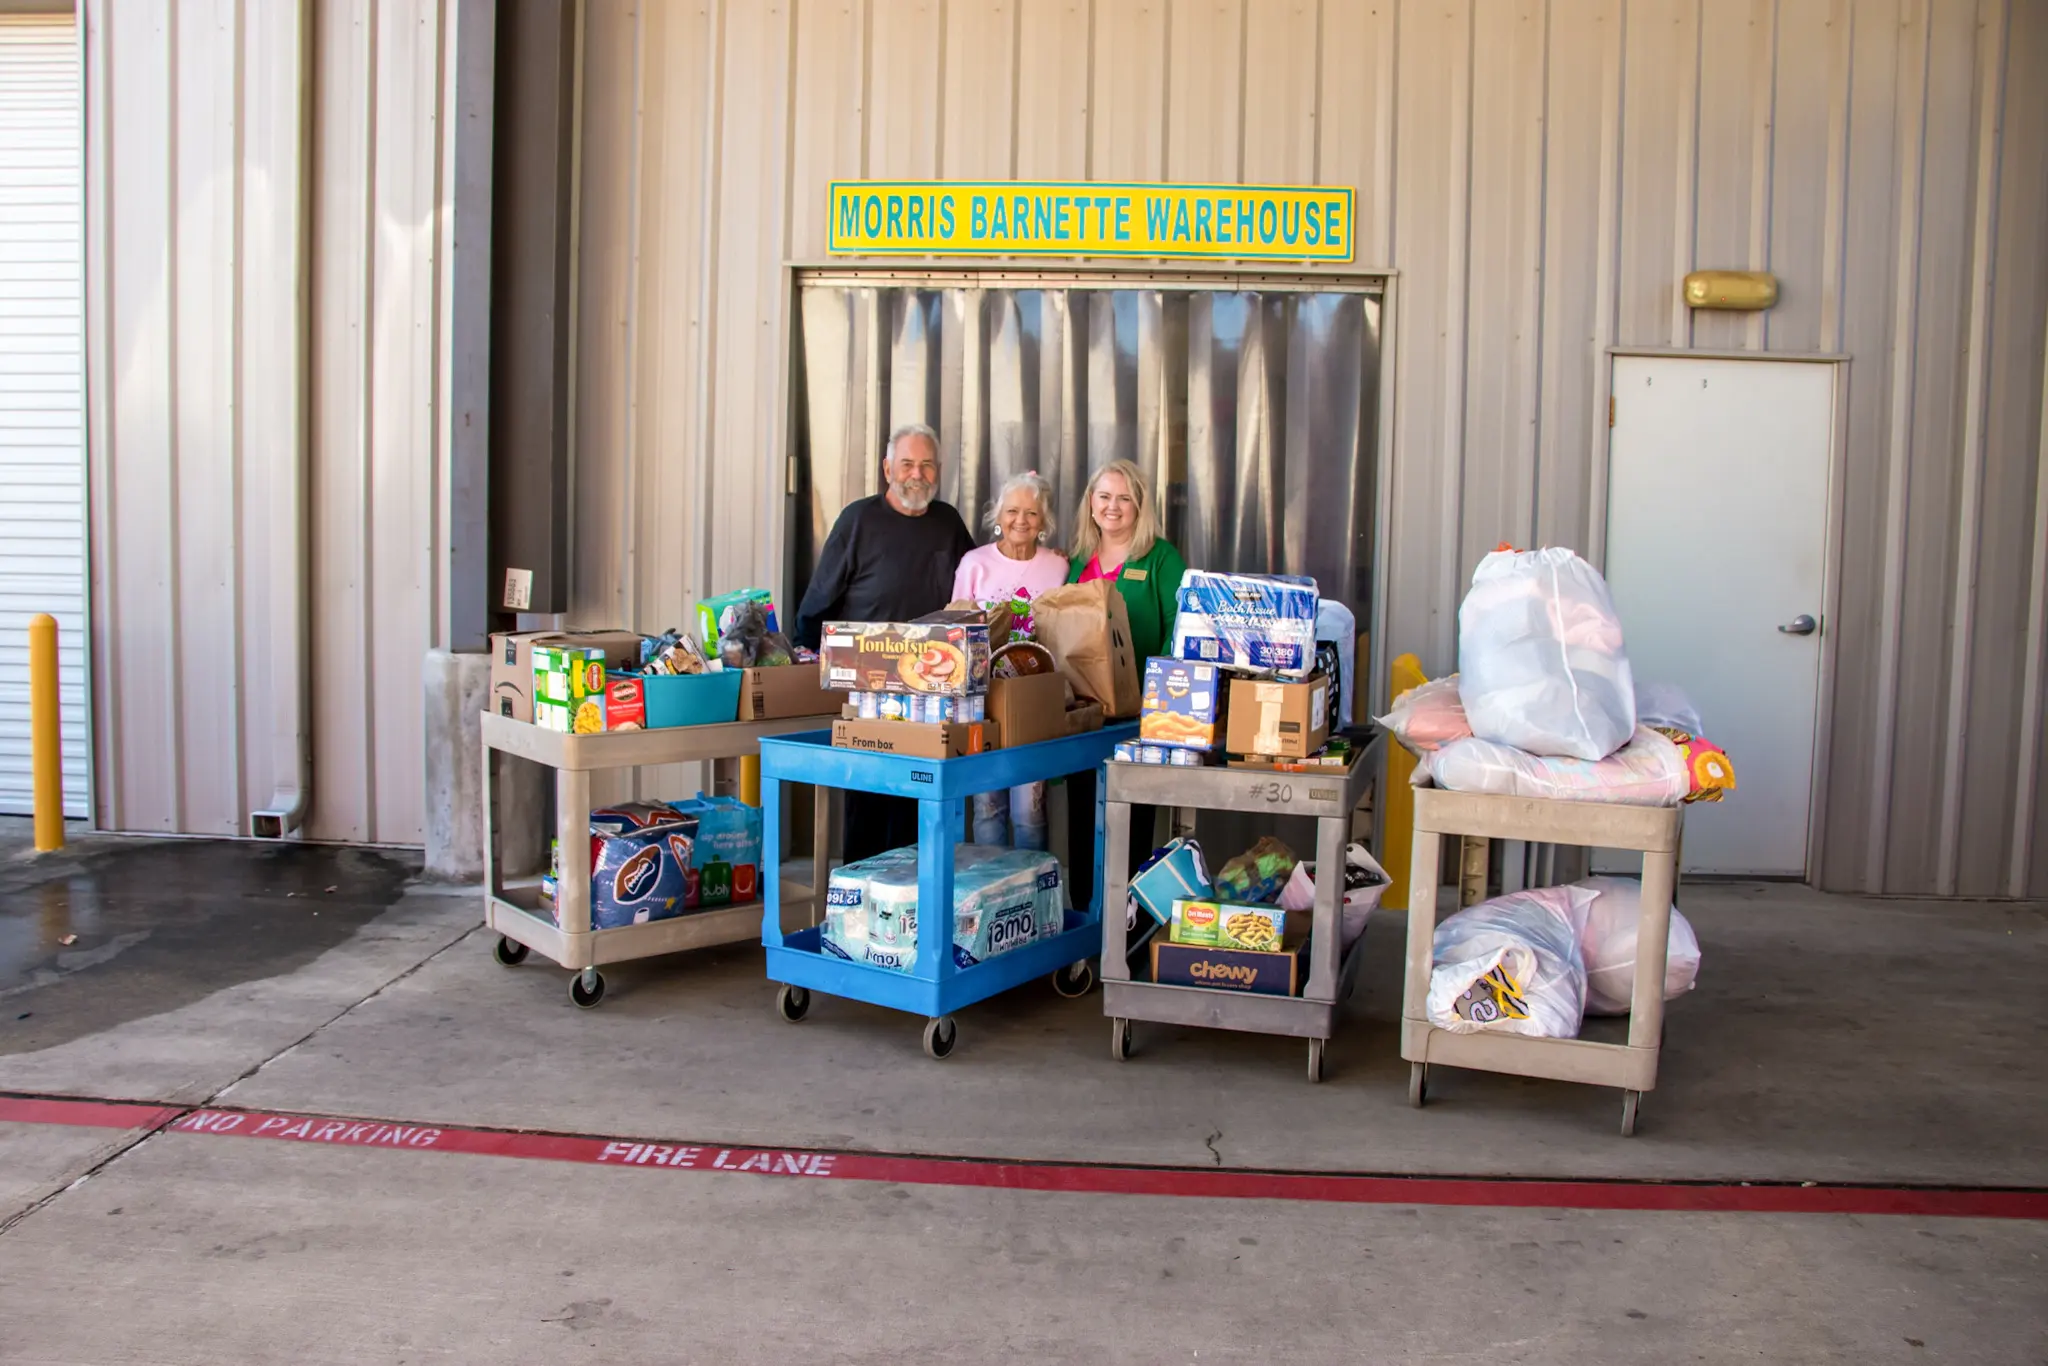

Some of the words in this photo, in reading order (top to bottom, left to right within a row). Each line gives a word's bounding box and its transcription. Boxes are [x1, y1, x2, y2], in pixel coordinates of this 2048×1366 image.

[839, 194, 956, 240] MORRIS
[970, 195, 1131, 241] BARNETTE
[1146, 197, 1342, 246] WAREHOUSE
[1245, 601, 1277, 615] Tissue
[855, 634, 929, 654] Tonkotsu
[852, 736, 876, 748] From
[877, 738, 894, 750] box
[911, 772, 933, 782] ULINE
[1249, 782, 1293, 803] #30
[846, 895, 858, 905] 12
[986, 912, 1038, 952] Towel
[864, 946, 902, 968] Towl
[1189, 960, 1258, 985] chewy
[182, 1112, 245, 1131] NO
[251, 1117, 441, 1147] PARKING
[597, 1141, 701, 1167] FIRE
[712, 1149, 837, 1175] LANE
